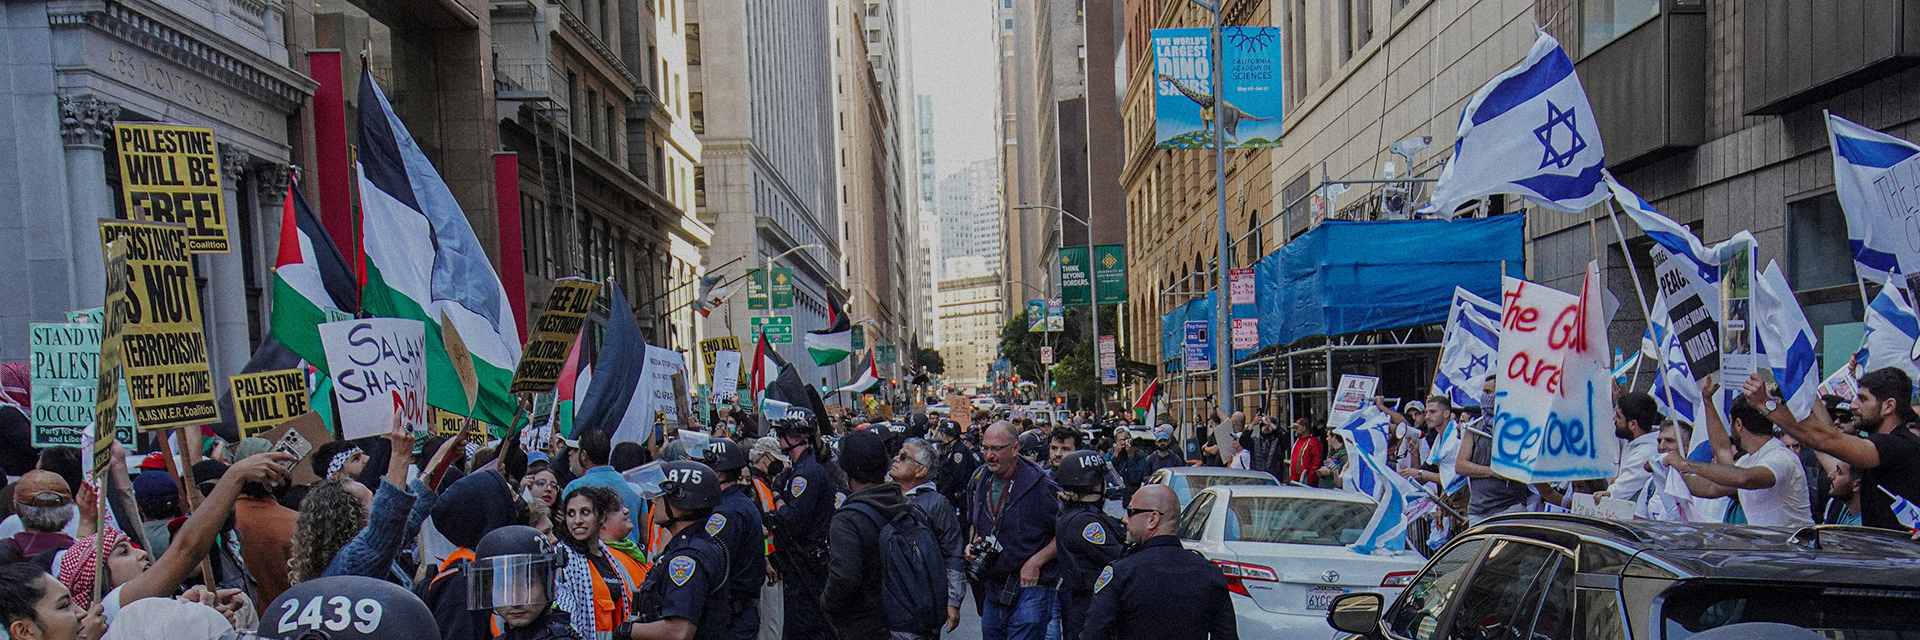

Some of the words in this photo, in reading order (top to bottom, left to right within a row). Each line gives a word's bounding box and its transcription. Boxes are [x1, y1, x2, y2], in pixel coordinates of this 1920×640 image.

[1155, 37, 1171, 46] THE
[1173, 36, 1207, 45] WORLD'S
[1156, 45, 1208, 57] LARGEST
[1157, 57, 1209, 80] DINO
[1232, 71, 1273, 80] SCIENCES
[142, 61, 233, 118] MONTGOMERY
[119, 127, 214, 155] PALESTINE
[124, 154, 185, 186] WILL
[186, 156, 218, 187] BE
[1873, 166, 1914, 220] THE
[130, 191, 224, 237] FREE!
[189, 240, 226, 250] Coalition
[1063, 278, 1090, 286] BORDERS.
[1660, 267, 1691, 299] PEAC
[122, 263, 142, 325] S
[142, 264, 193, 323] NOT
[544, 285, 575, 312] FREE
[568, 287, 594, 314] ALL
[1689, 305, 1710, 326] WANT
[34, 327, 84, 346] STAND
[701, 339, 720, 353] END
[721, 338, 738, 350] ALL
[1685, 327, 1718, 364] WAR!
[122, 331, 207, 368] TERRORISM!
[524, 340, 568, 361] POLITICAL
[34, 351, 125, 380] PALEST
[51, 387, 82, 402] END
[130, 374, 155, 400] FREE
[157, 369, 211, 398] PALESTINE!
[233, 372, 305, 398] PALESTINE
[35, 404, 131, 423] OCCUPAN!
[184, 404, 215, 417] Coalition
[238, 395, 284, 424] WILL
[284, 391, 308, 418] BE
[391, 385, 425, 427] NOW
[40, 428, 60, 436] Party
[442, 418, 481, 433] POLIAL
[710, 442, 726, 454] 711
[667, 468, 702, 485] 875
[277, 594, 383, 635] 2439
